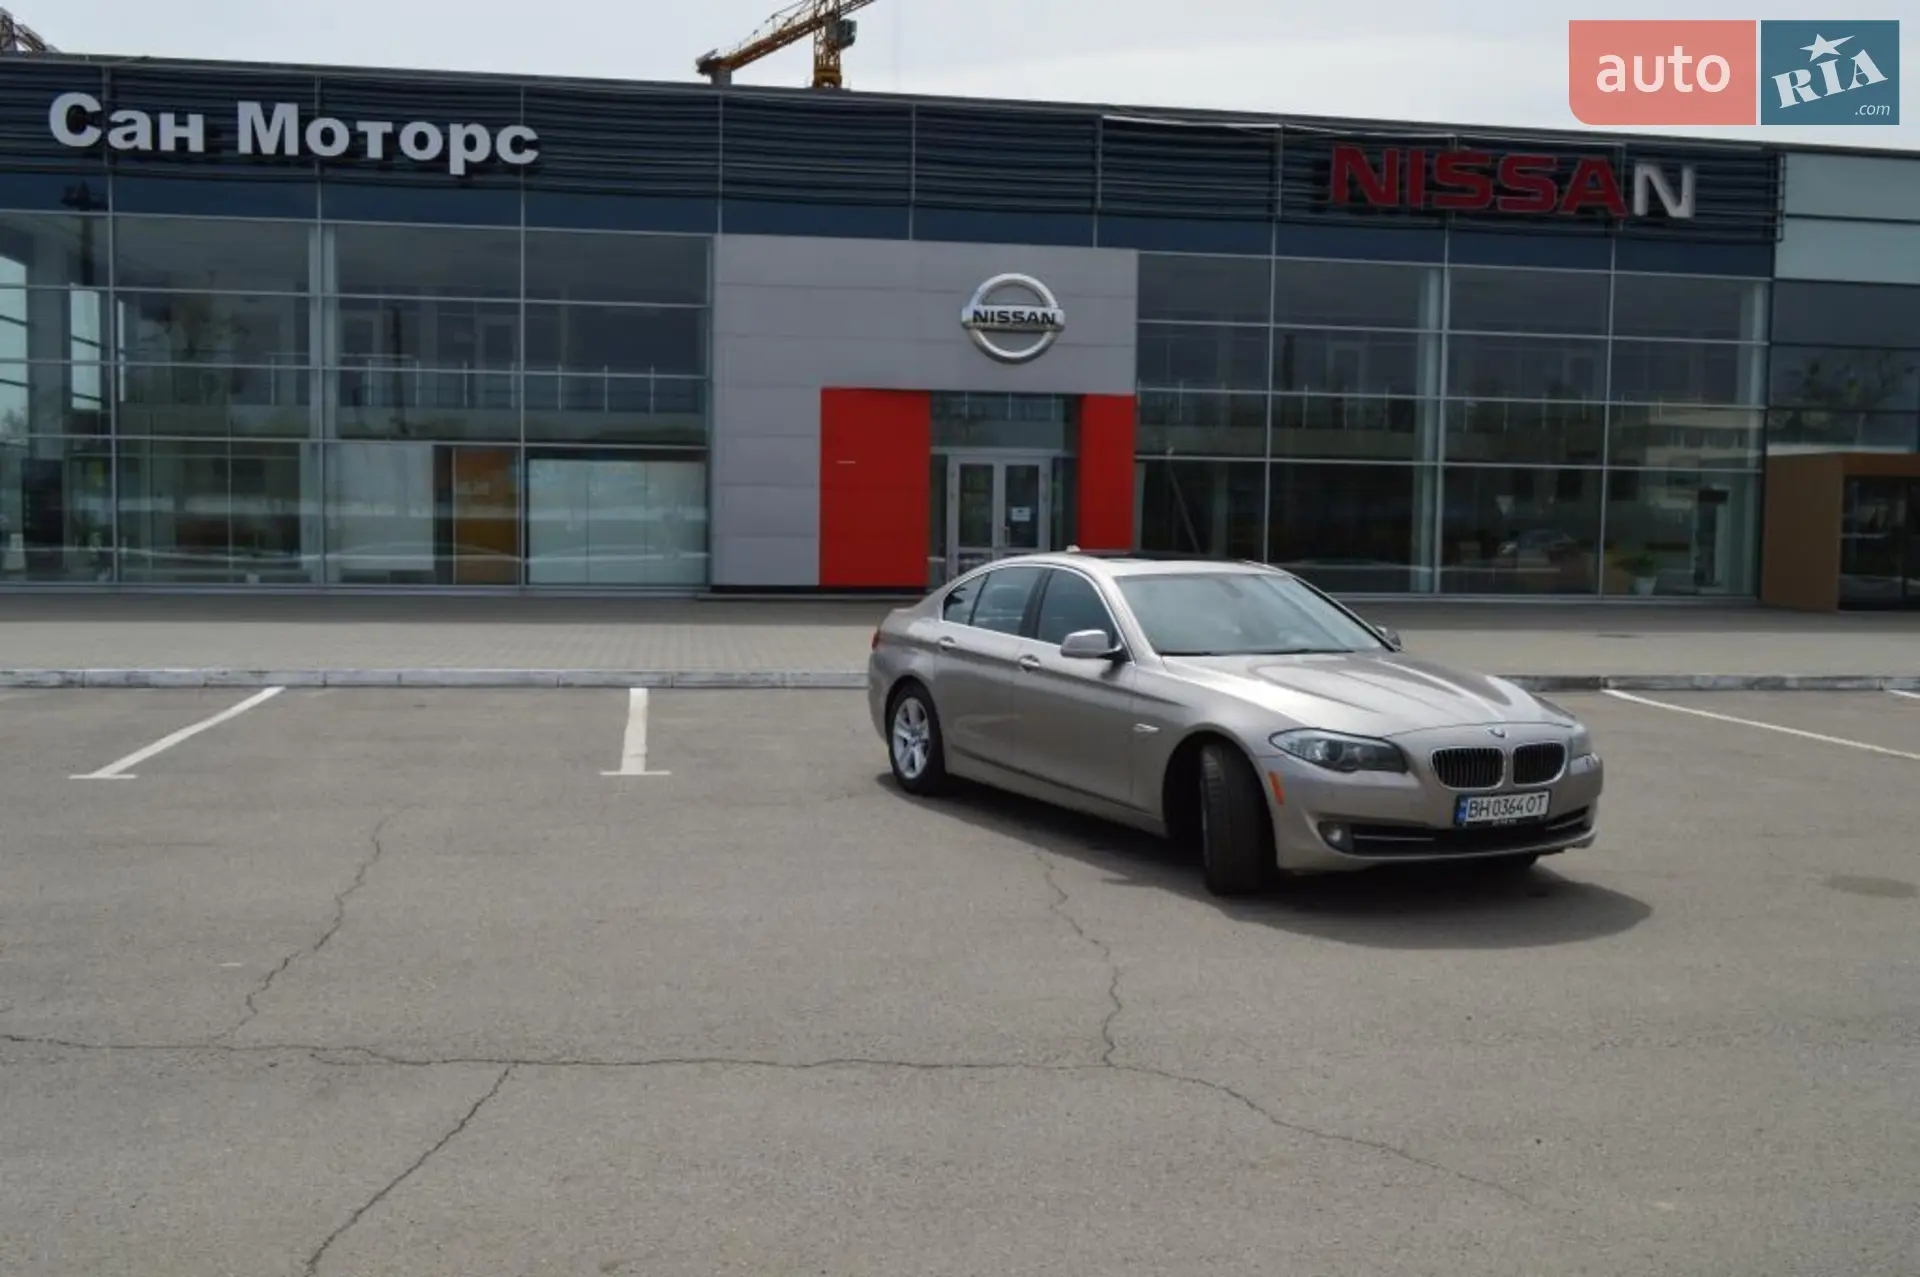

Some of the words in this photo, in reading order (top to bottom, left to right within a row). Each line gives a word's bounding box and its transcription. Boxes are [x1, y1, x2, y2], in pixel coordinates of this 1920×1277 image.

[49, 92, 204, 152] Сан
[237, 102, 540, 175] Моторс
[1331, 145, 1694, 218] NISSAN
[973, 309, 1054, 325] NISSAN
